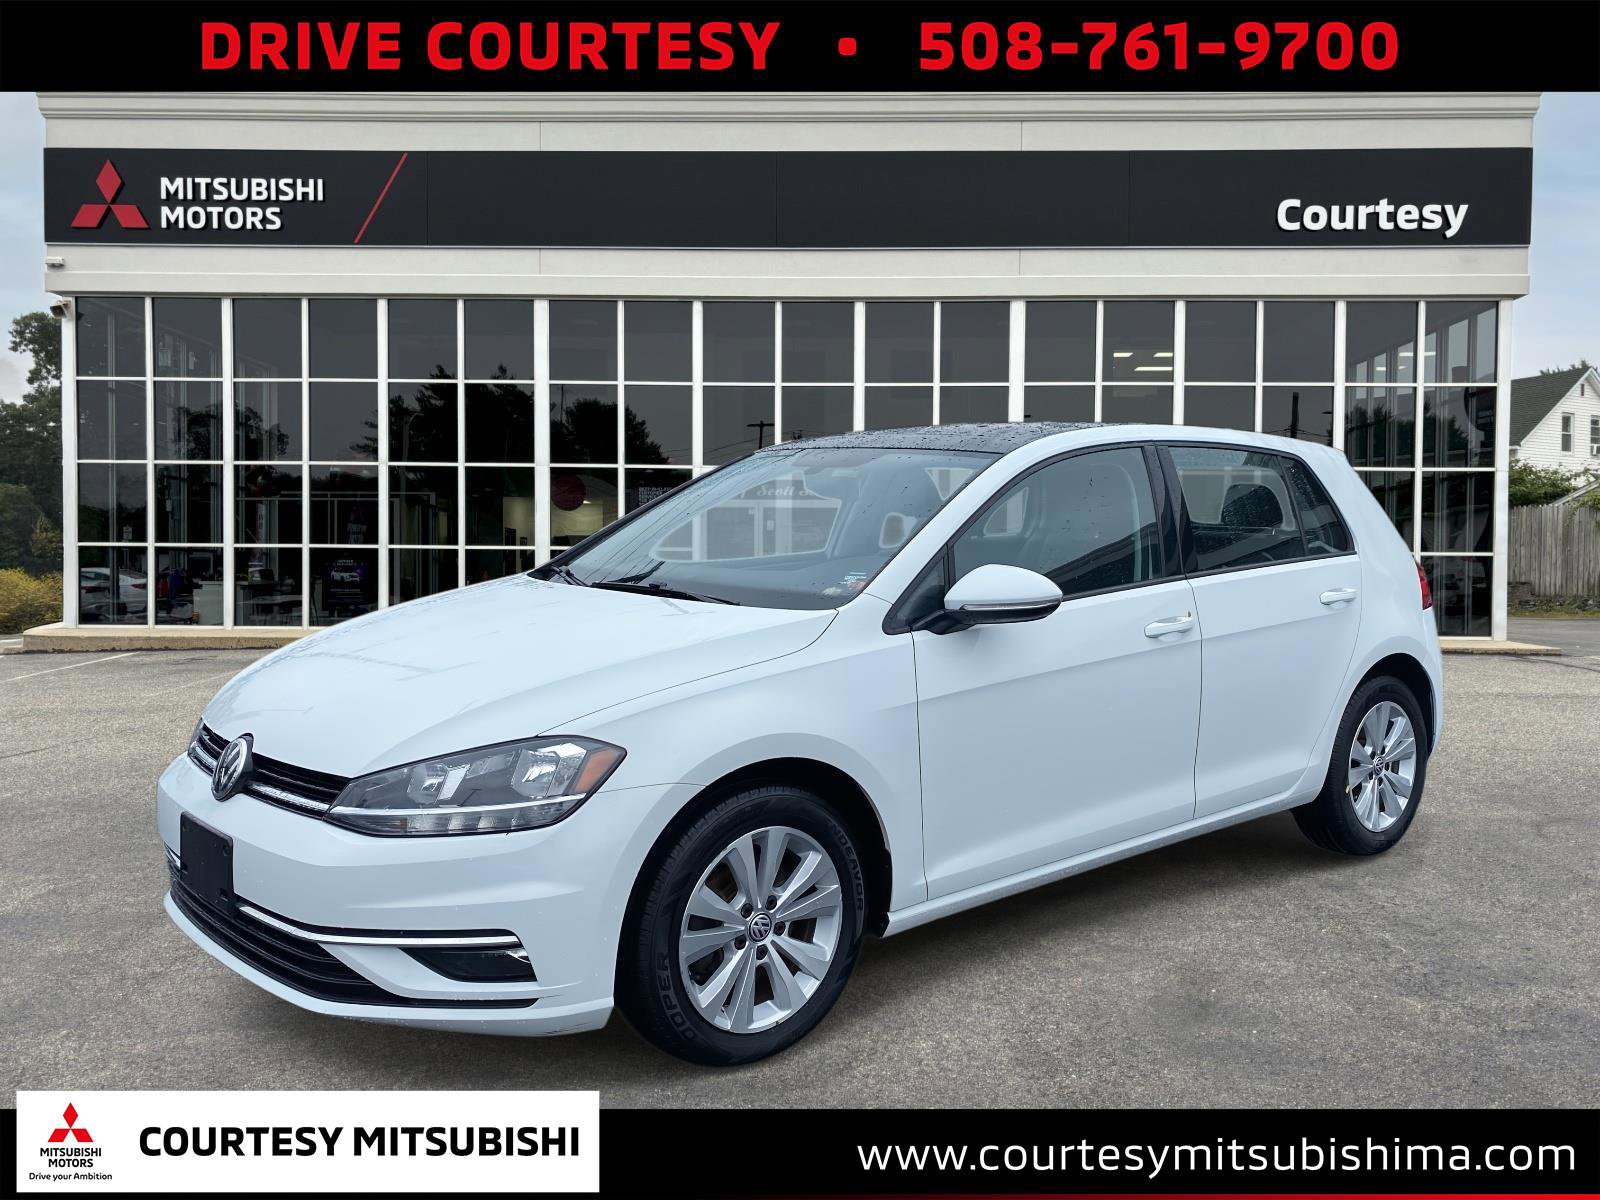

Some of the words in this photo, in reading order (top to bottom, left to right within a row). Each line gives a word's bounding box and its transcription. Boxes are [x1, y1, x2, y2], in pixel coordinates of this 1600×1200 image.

[160, 176, 324, 201] MITSUBISHI
[160, 205, 282, 230] MOTORS
[1277, 197, 1469, 238] Courtesy
[655, 951, 702, 1042] OOPER
